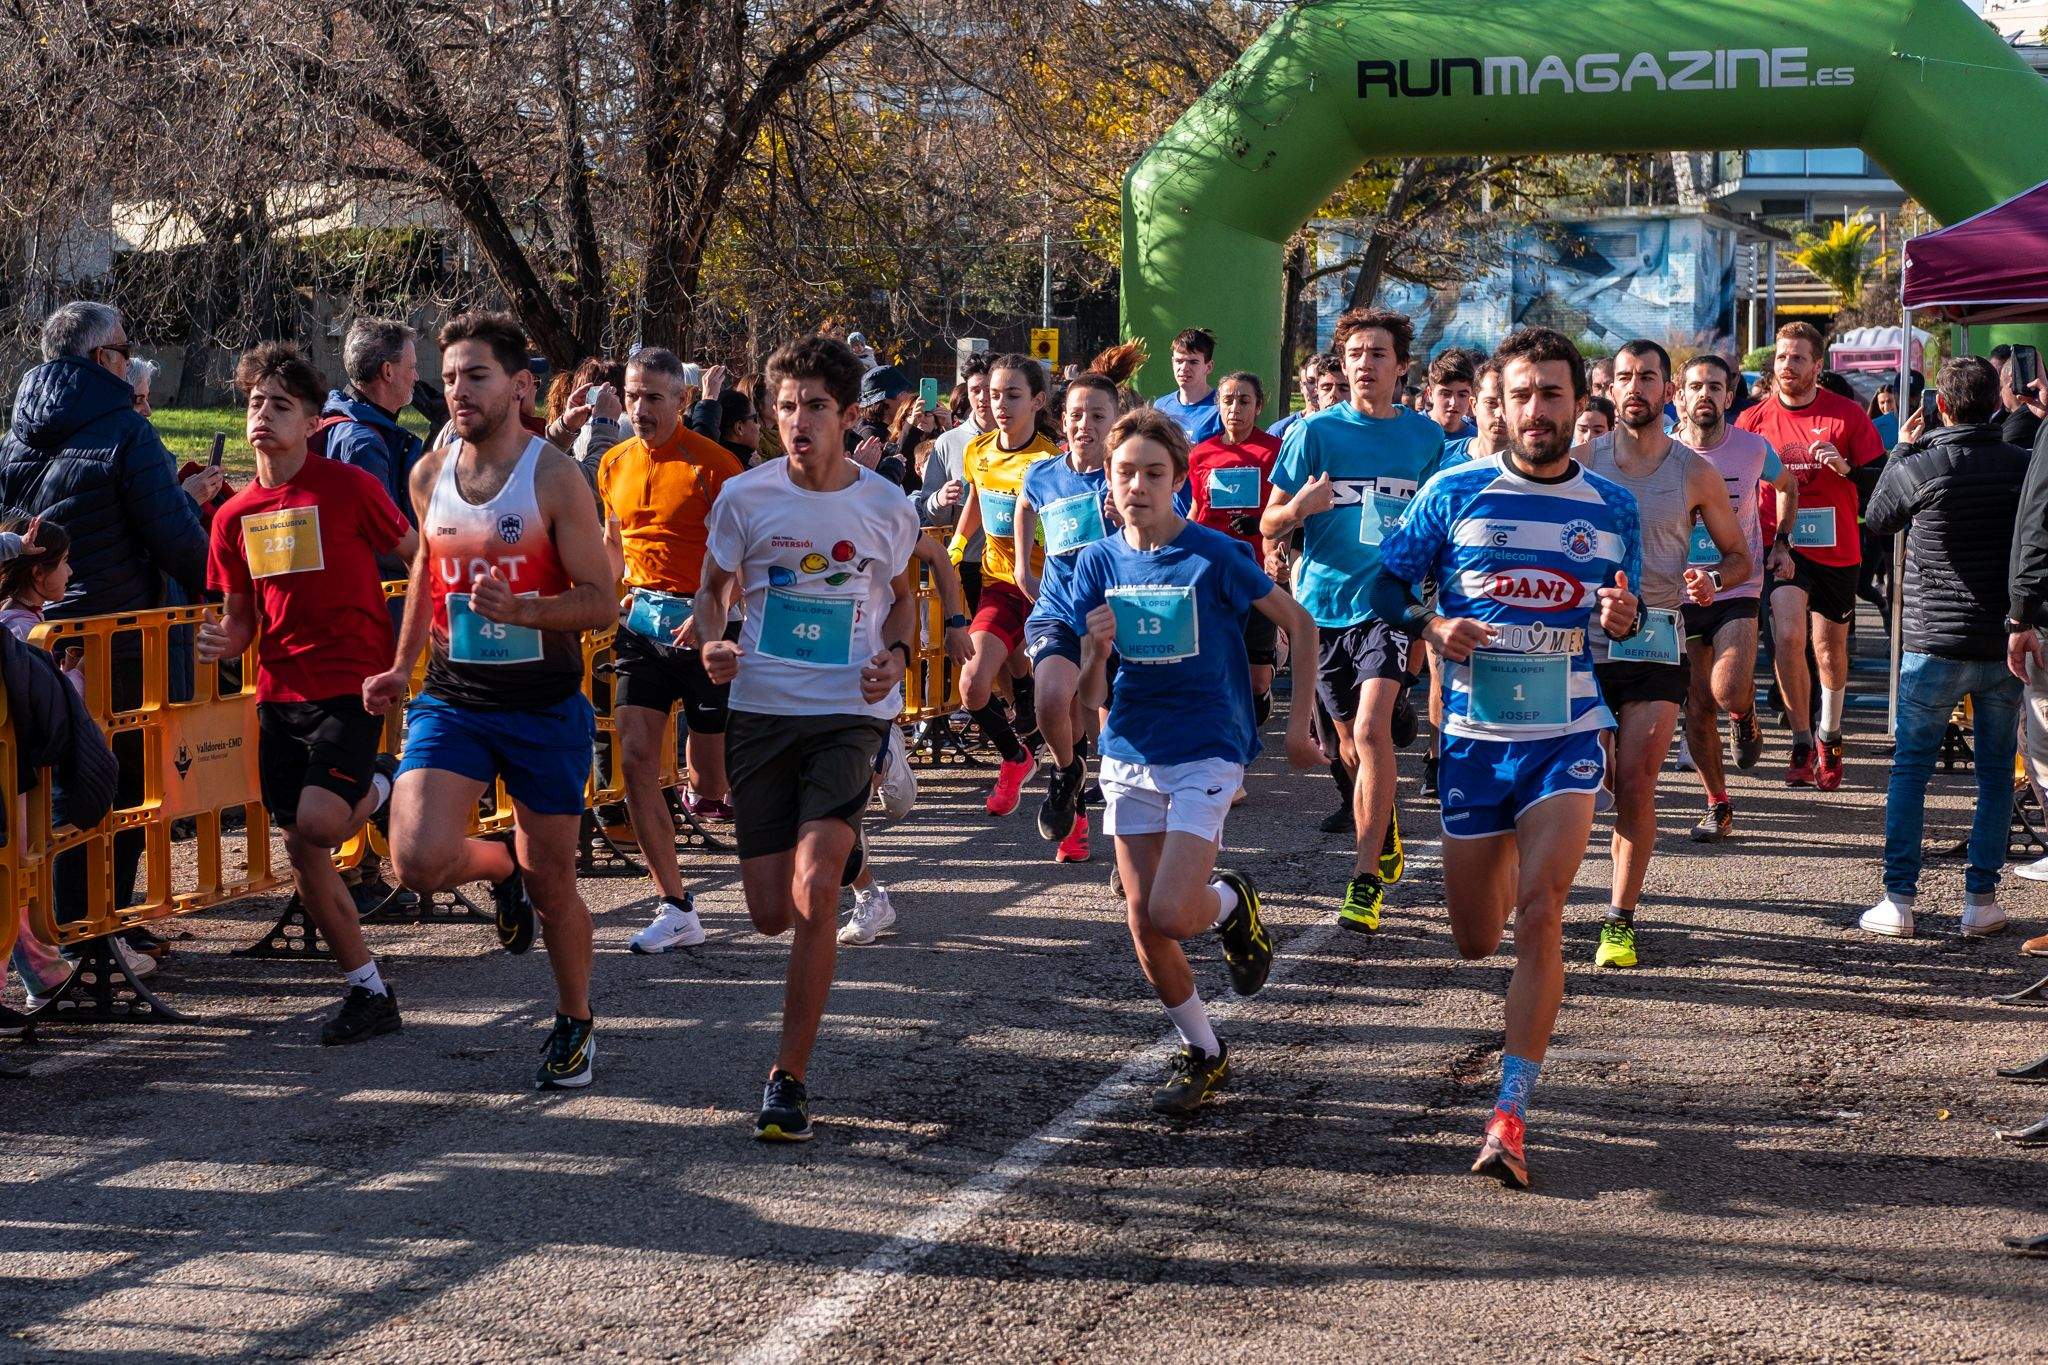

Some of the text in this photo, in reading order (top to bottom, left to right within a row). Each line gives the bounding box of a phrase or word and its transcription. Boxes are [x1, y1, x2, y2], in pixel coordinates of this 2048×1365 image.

[1227, 483, 1241, 494] 47
[996, 511, 1012, 523] 46
[271, 519, 308, 529] INCLUSIVA
[1060, 517, 1079, 532] 33
[1800, 523, 1816, 534] 10
[263, 535, 296, 554] 229
[1698, 538, 1716, 550] 64
[1492, 575, 1567, 603] DANI
[479, 623, 507, 639] 45
[792, 623, 821, 640] 48
[1136, 617, 1162, 635] 13
[1644, 629, 1655, 643] 7
[479, 647, 509, 658] XAVI
[795, 648, 813, 658] OT
[1128, 644, 1176, 654] HECTOR
[1624, 648, 1670, 658] BERTRAN
[1490, 666, 1545, 674] MILLA OPEN
[1512, 684, 1526, 701] 1
[1497, 710, 1541, 720] JOSEP
[196, 736, 243, 754] Valldoreix-EMD
